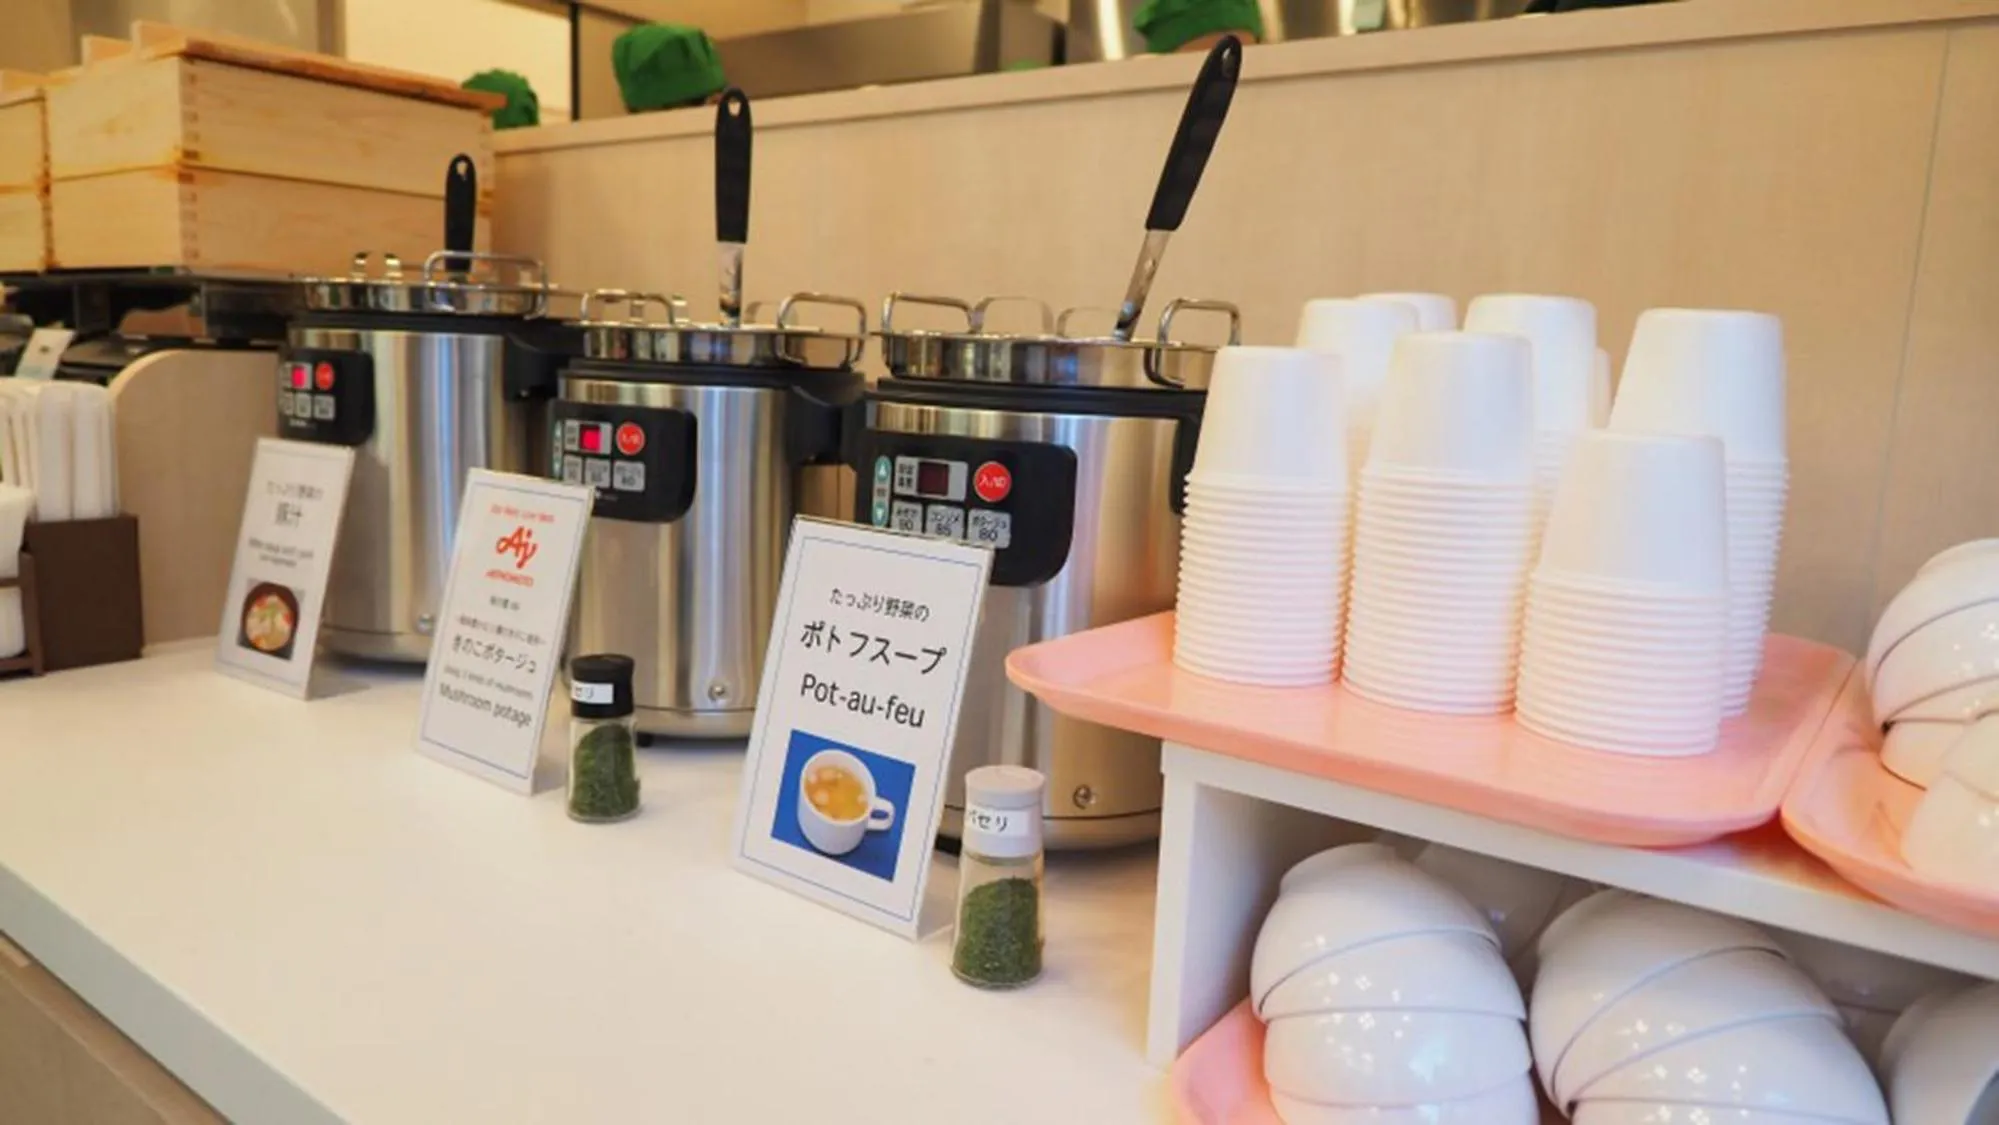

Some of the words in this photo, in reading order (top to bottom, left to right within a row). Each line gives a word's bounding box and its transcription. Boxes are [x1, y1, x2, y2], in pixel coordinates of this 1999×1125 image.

[830, 588, 930, 622] たっぷり野菜の
[452, 633, 537, 674] きのこポタージュ
[800, 620, 948, 675] ポトフスープ
[493, 702, 533, 729] potage
[800, 672, 926, 729] Pot-au-feu
